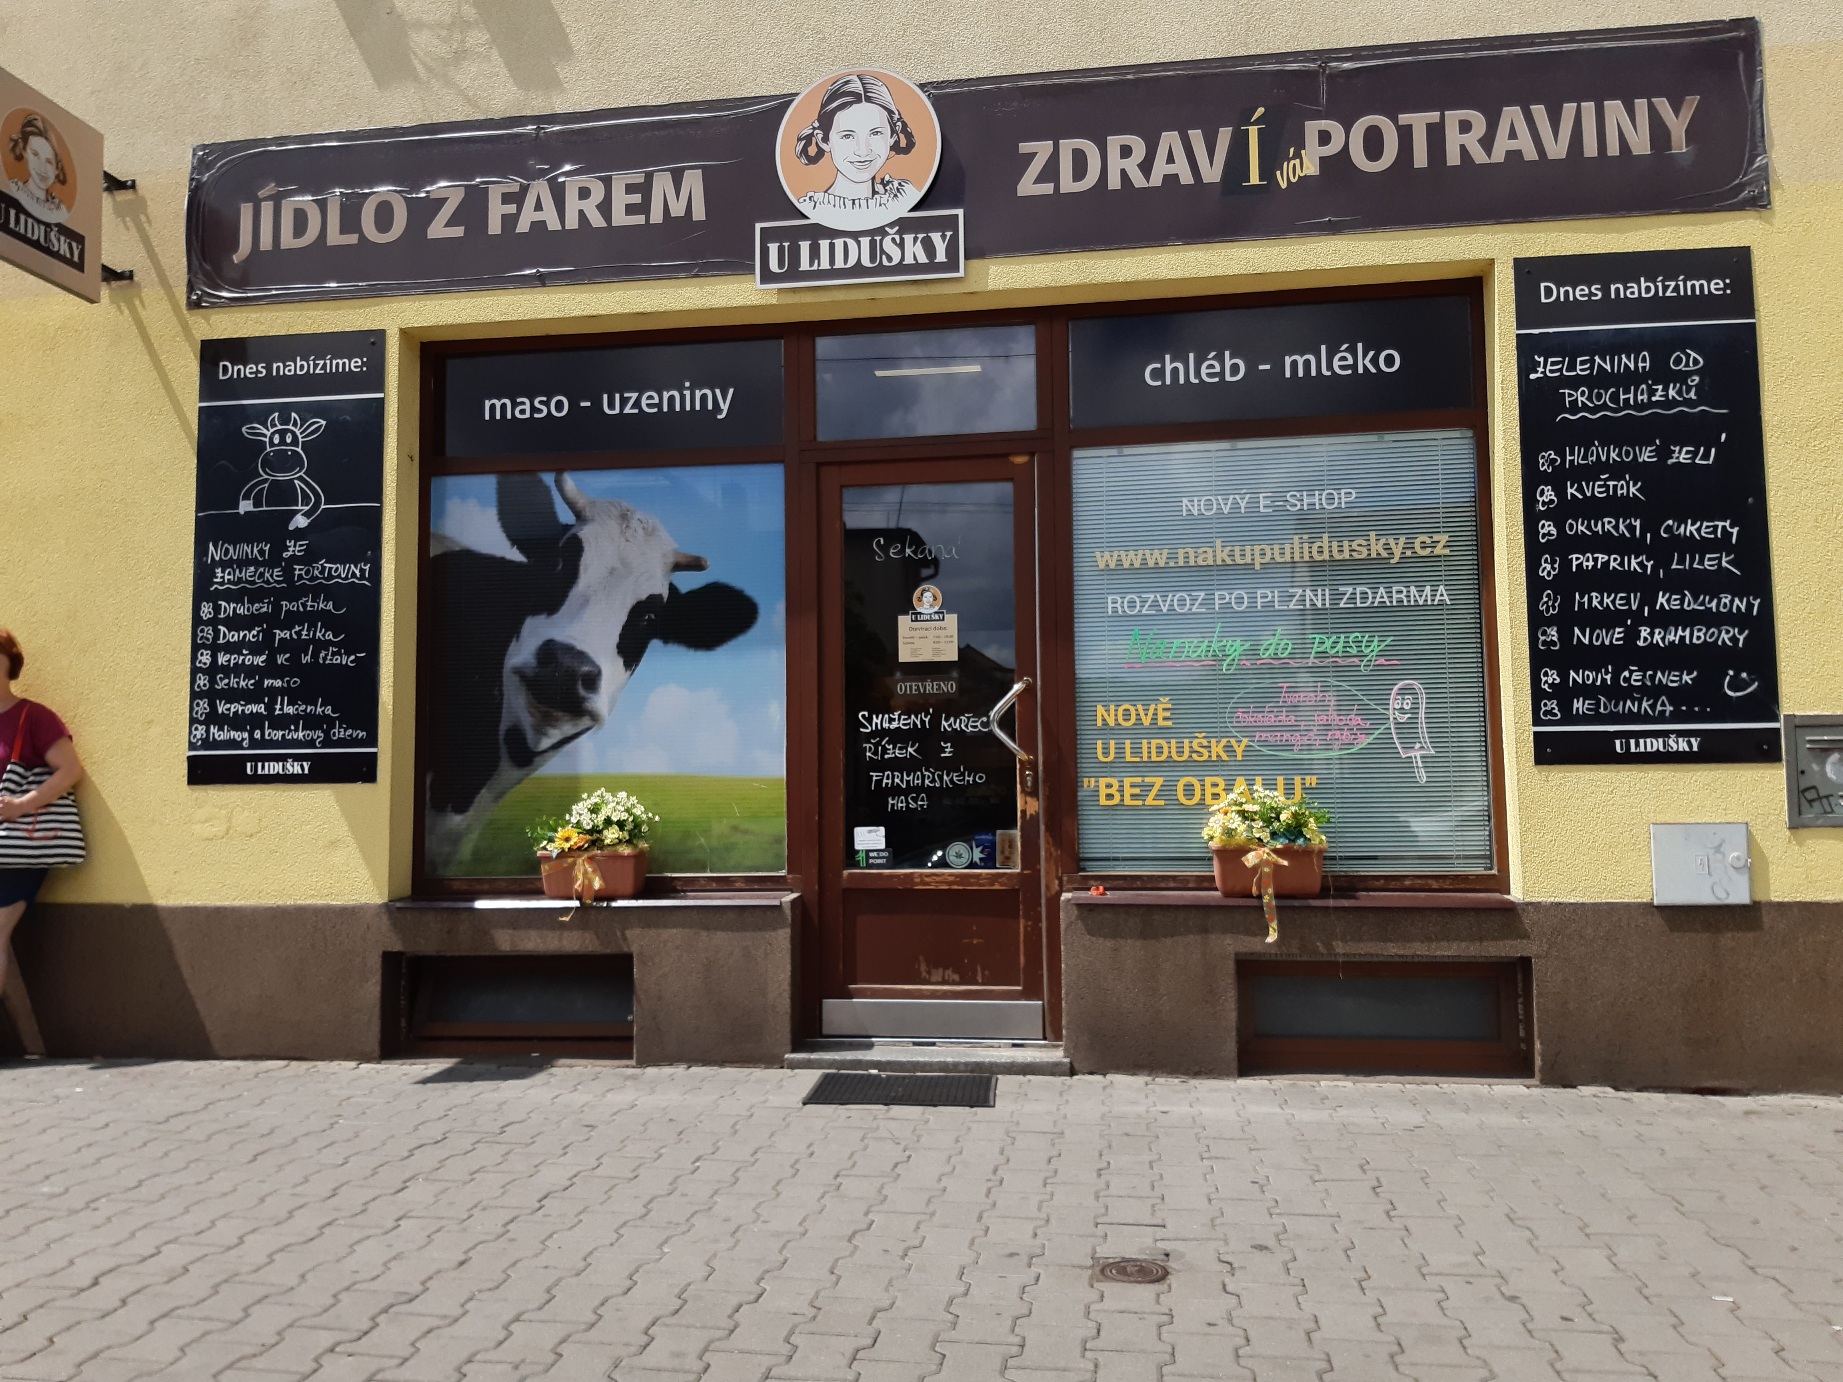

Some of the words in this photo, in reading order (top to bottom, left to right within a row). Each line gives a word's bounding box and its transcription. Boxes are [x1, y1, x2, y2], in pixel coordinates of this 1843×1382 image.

[1016, 106, 1267, 197] ZDRAVÍ
[1304, 95, 1700, 175] POTRAVINY
[233, 182, 408, 264] JÍDLO
[426, 188, 465, 239] Z
[487, 169, 707, 237] FAREM
[8, 207, 82, 263] LIDUŠKY
[766, 242, 791, 274] U
[798, 226, 954, 271] LIDUŠKY
[1539, 282, 1602, 303] Dnes
[1610, 275, 1732, 299] nabízíme:
[218, 361, 267, 380] Dnes
[272, 355, 368, 377] nabízíme:
[1144, 350, 1246, 386] chléb
[1284, 342, 1401, 378] mléko
[1529, 351, 1650, 380] ZELENINA
[1669, 349, 1704, 371] OD
[484, 395, 569, 420] maso
[602, 381, 734, 419] uzeniny
[1559, 375, 1700, 408] PROCHÁZKŮ
[1565, 438, 1660, 469] HLÁVKOVÉ
[1566, 474, 1647, 501] KVĚTÁK
[1181, 489, 1250, 517] NOVÝ
[1259, 488, 1357, 514] E-SHOP
[1565, 517, 1651, 545] OKURKY,
[1660, 519, 1740, 545] CUKETY
[207, 541, 270, 564] NOVINKY
[1094, 531, 1451, 570] www.nakupulidusky.cz
[1568, 552, 1664, 579] PAPRIKY,
[1671, 551, 1742, 576] LILEK
[280, 594, 347, 620] paštika
[1107, 592, 1206, 615] ROZVOZ
[1214, 590, 1248, 611] PO
[1256, 588, 1331, 610] PLZNI
[1338, 585, 1451, 608] ZDARMA
[1574, 592, 1649, 617] MRKEV,
[1655, 590, 1761, 616] KEDLUBNY
[216, 623, 267, 644] Dančí
[273, 621, 345, 647] paštika
[1572, 619, 1632, 646] NOVÉ
[1636, 626, 1749, 648] BRAMBORY
[217, 649, 268, 667] Vepřové
[277, 653, 290, 665] ve
[1126, 622, 1251, 674] Nanuky
[1259, 628, 1293, 658] do
[215, 673, 259, 689] Selské
[264, 677, 301, 689] maso
[897, 680, 956, 694] OTEVŘENO
[1569, 665, 1612, 688] NOVÝ
[216, 697, 268, 717] Vepřová
[1095, 697, 1173, 727] NOVĚ
[254, 729, 262, 740] a
[1095, 742, 1116, 763] U
[1124, 733, 1249, 763] LIDUŠKY
[1614, 739, 1626, 753] U
[1629, 734, 1701, 753] LIDUŠKY
[246, 762, 255, 775] U
[257, 759, 311, 775] LIDUŠKY
[888, 793, 928, 812] MASA
[1082, 776, 1166, 806] "BEZ
